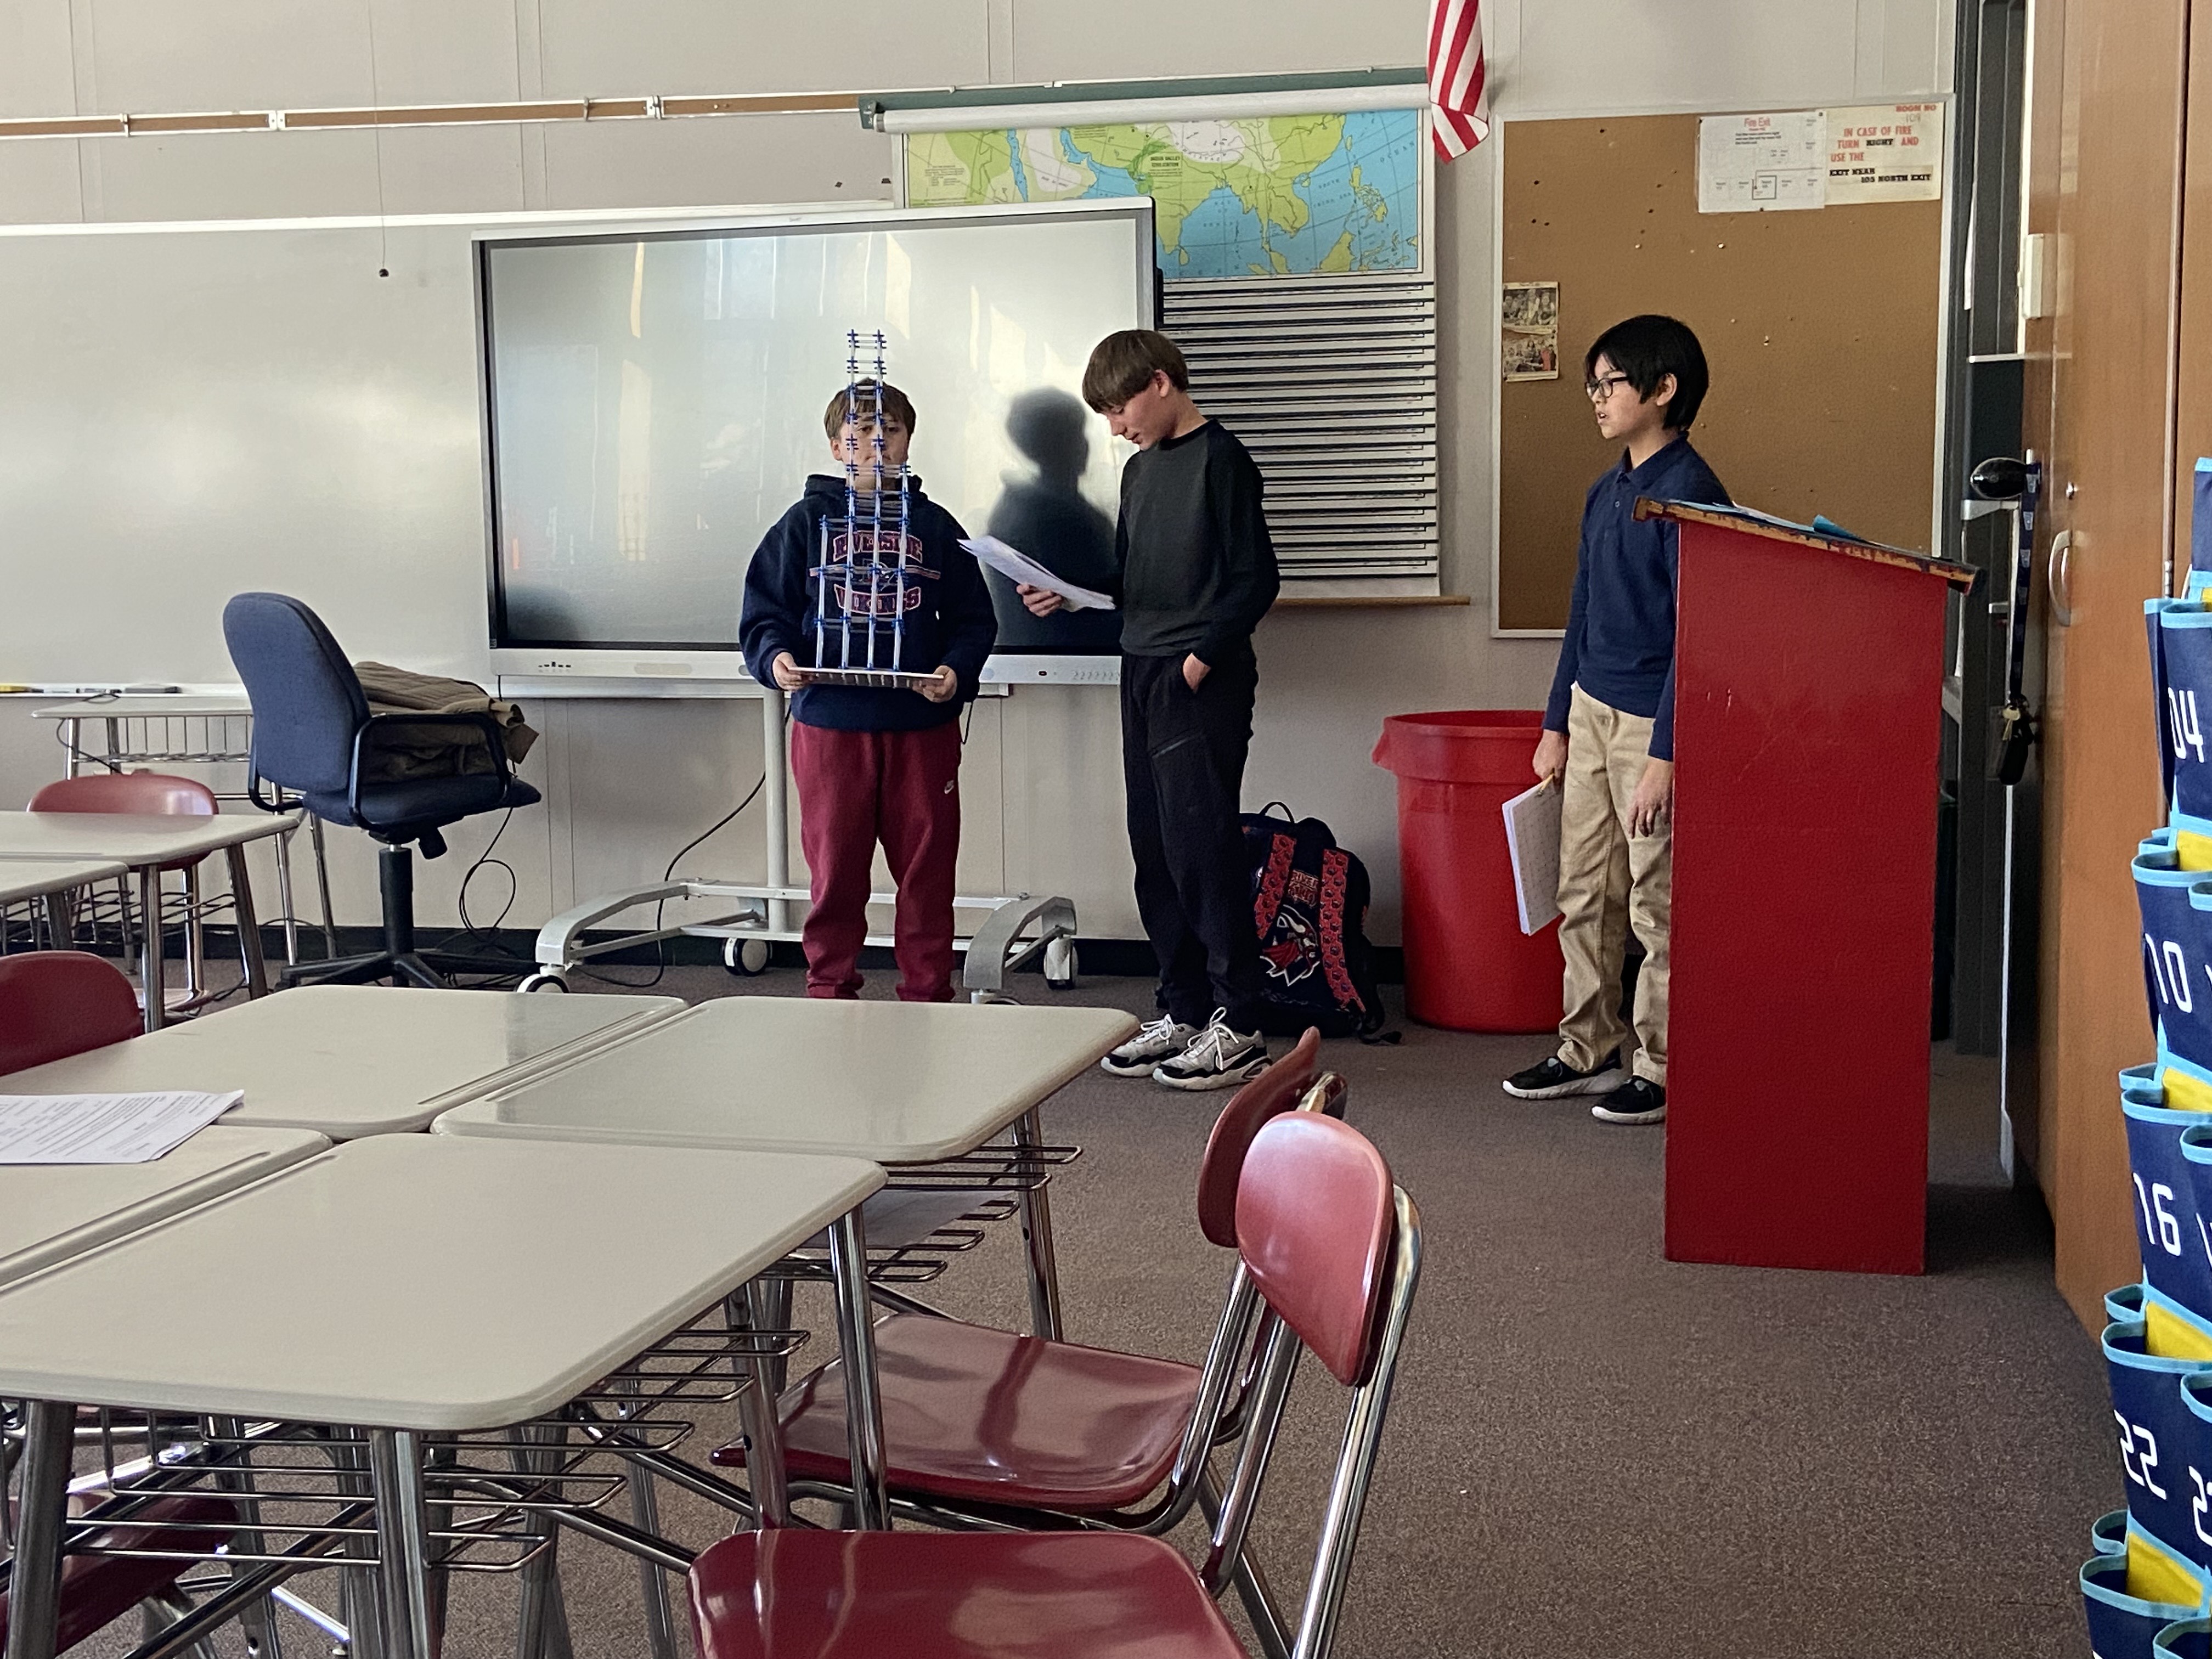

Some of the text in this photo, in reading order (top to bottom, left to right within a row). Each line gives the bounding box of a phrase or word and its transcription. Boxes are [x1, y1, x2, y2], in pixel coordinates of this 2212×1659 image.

[1844, 126, 1912, 137] IN CASE OF FIRE
[1837, 137, 1919, 149] TURN RIGHT AND
[1830, 152, 1864, 162] USE THE
[1878, 174, 1908, 183] NORTH
[2145, 933, 2192, 1013] 10
[2133, 1172, 2181, 1256] 16
[2113, 1409, 2167, 1500] 22
